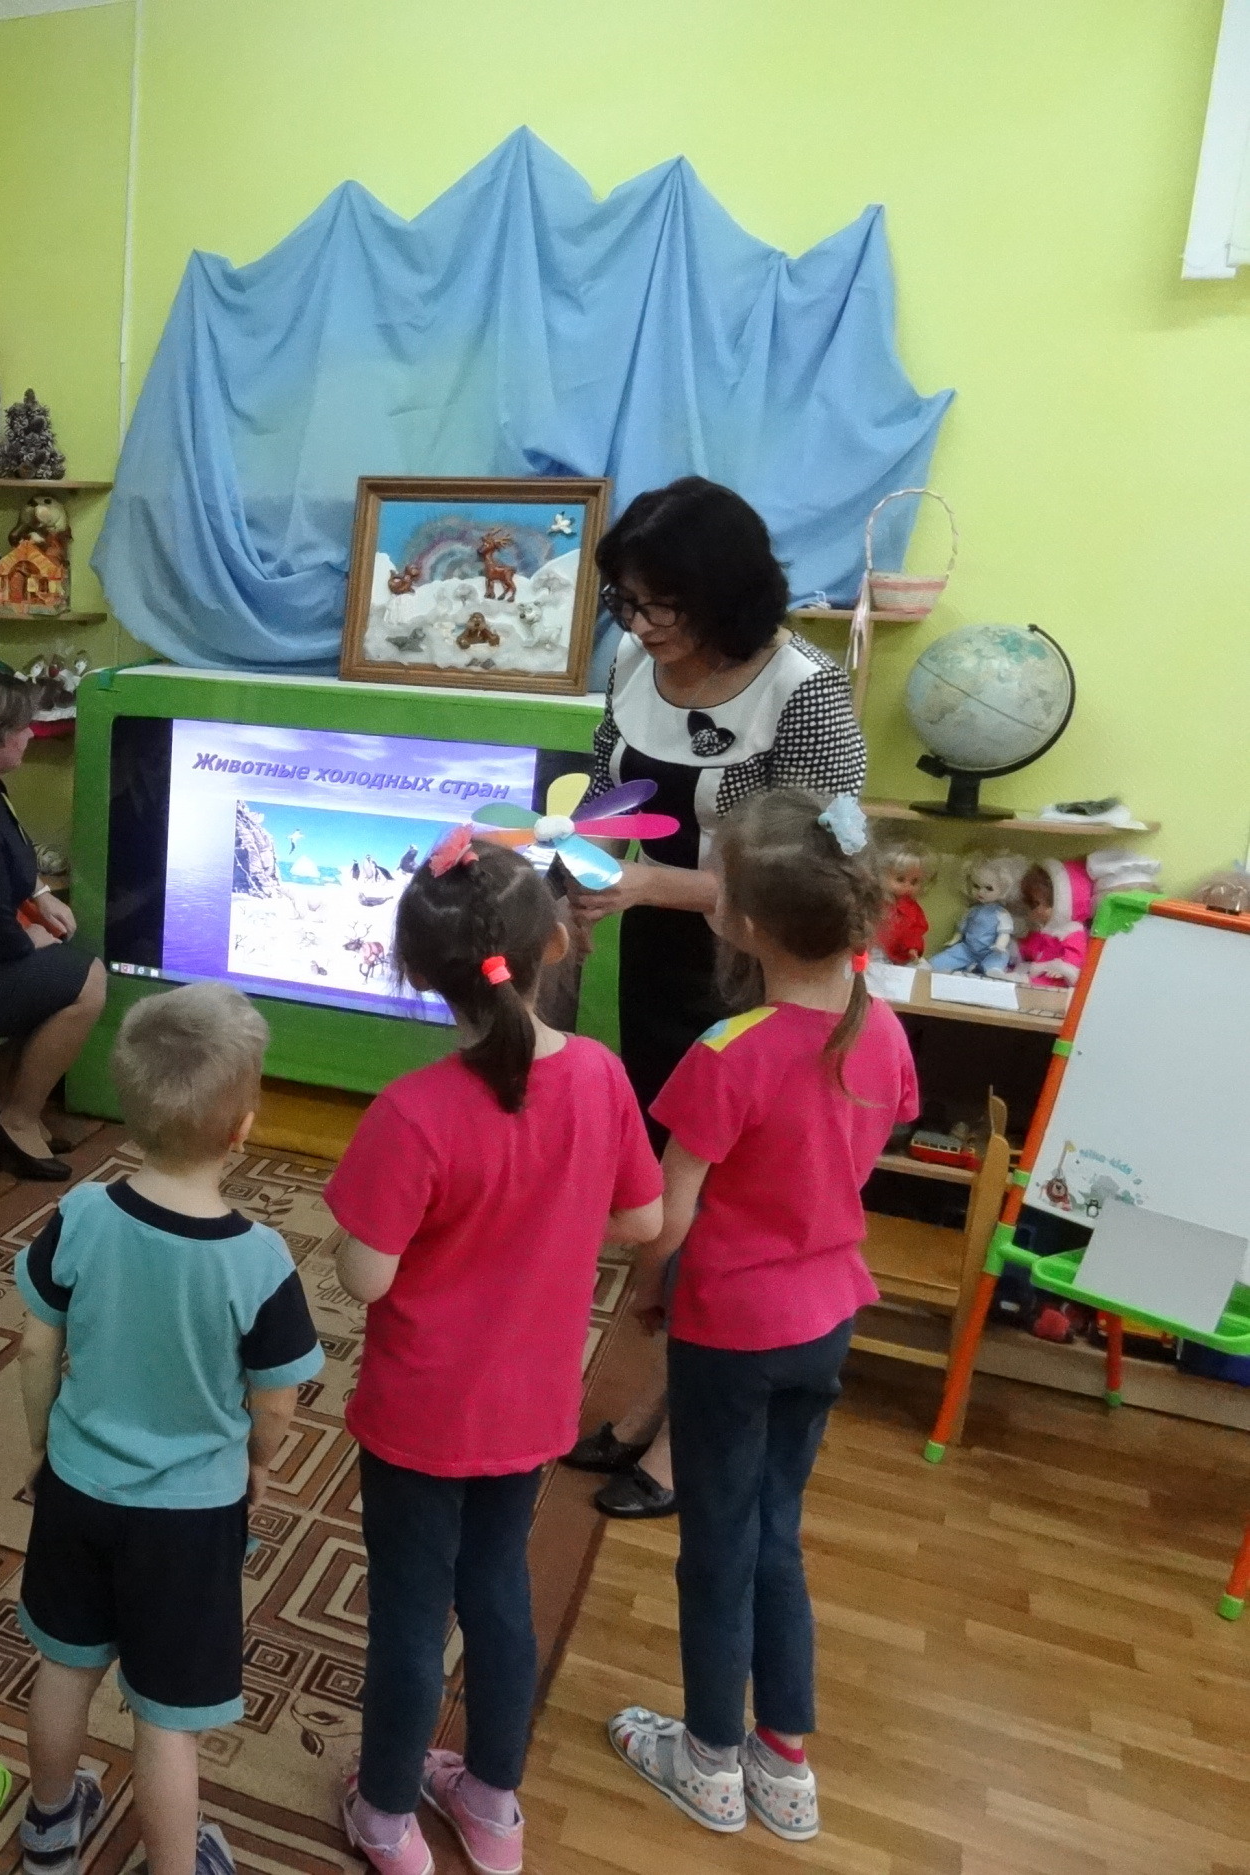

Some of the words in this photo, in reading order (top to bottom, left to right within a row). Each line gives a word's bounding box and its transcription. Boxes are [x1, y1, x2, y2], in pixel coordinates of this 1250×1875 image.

[192, 752, 310, 781] Животные
[313, 766, 434, 793] холодных
[438, 778, 510, 800] стран
